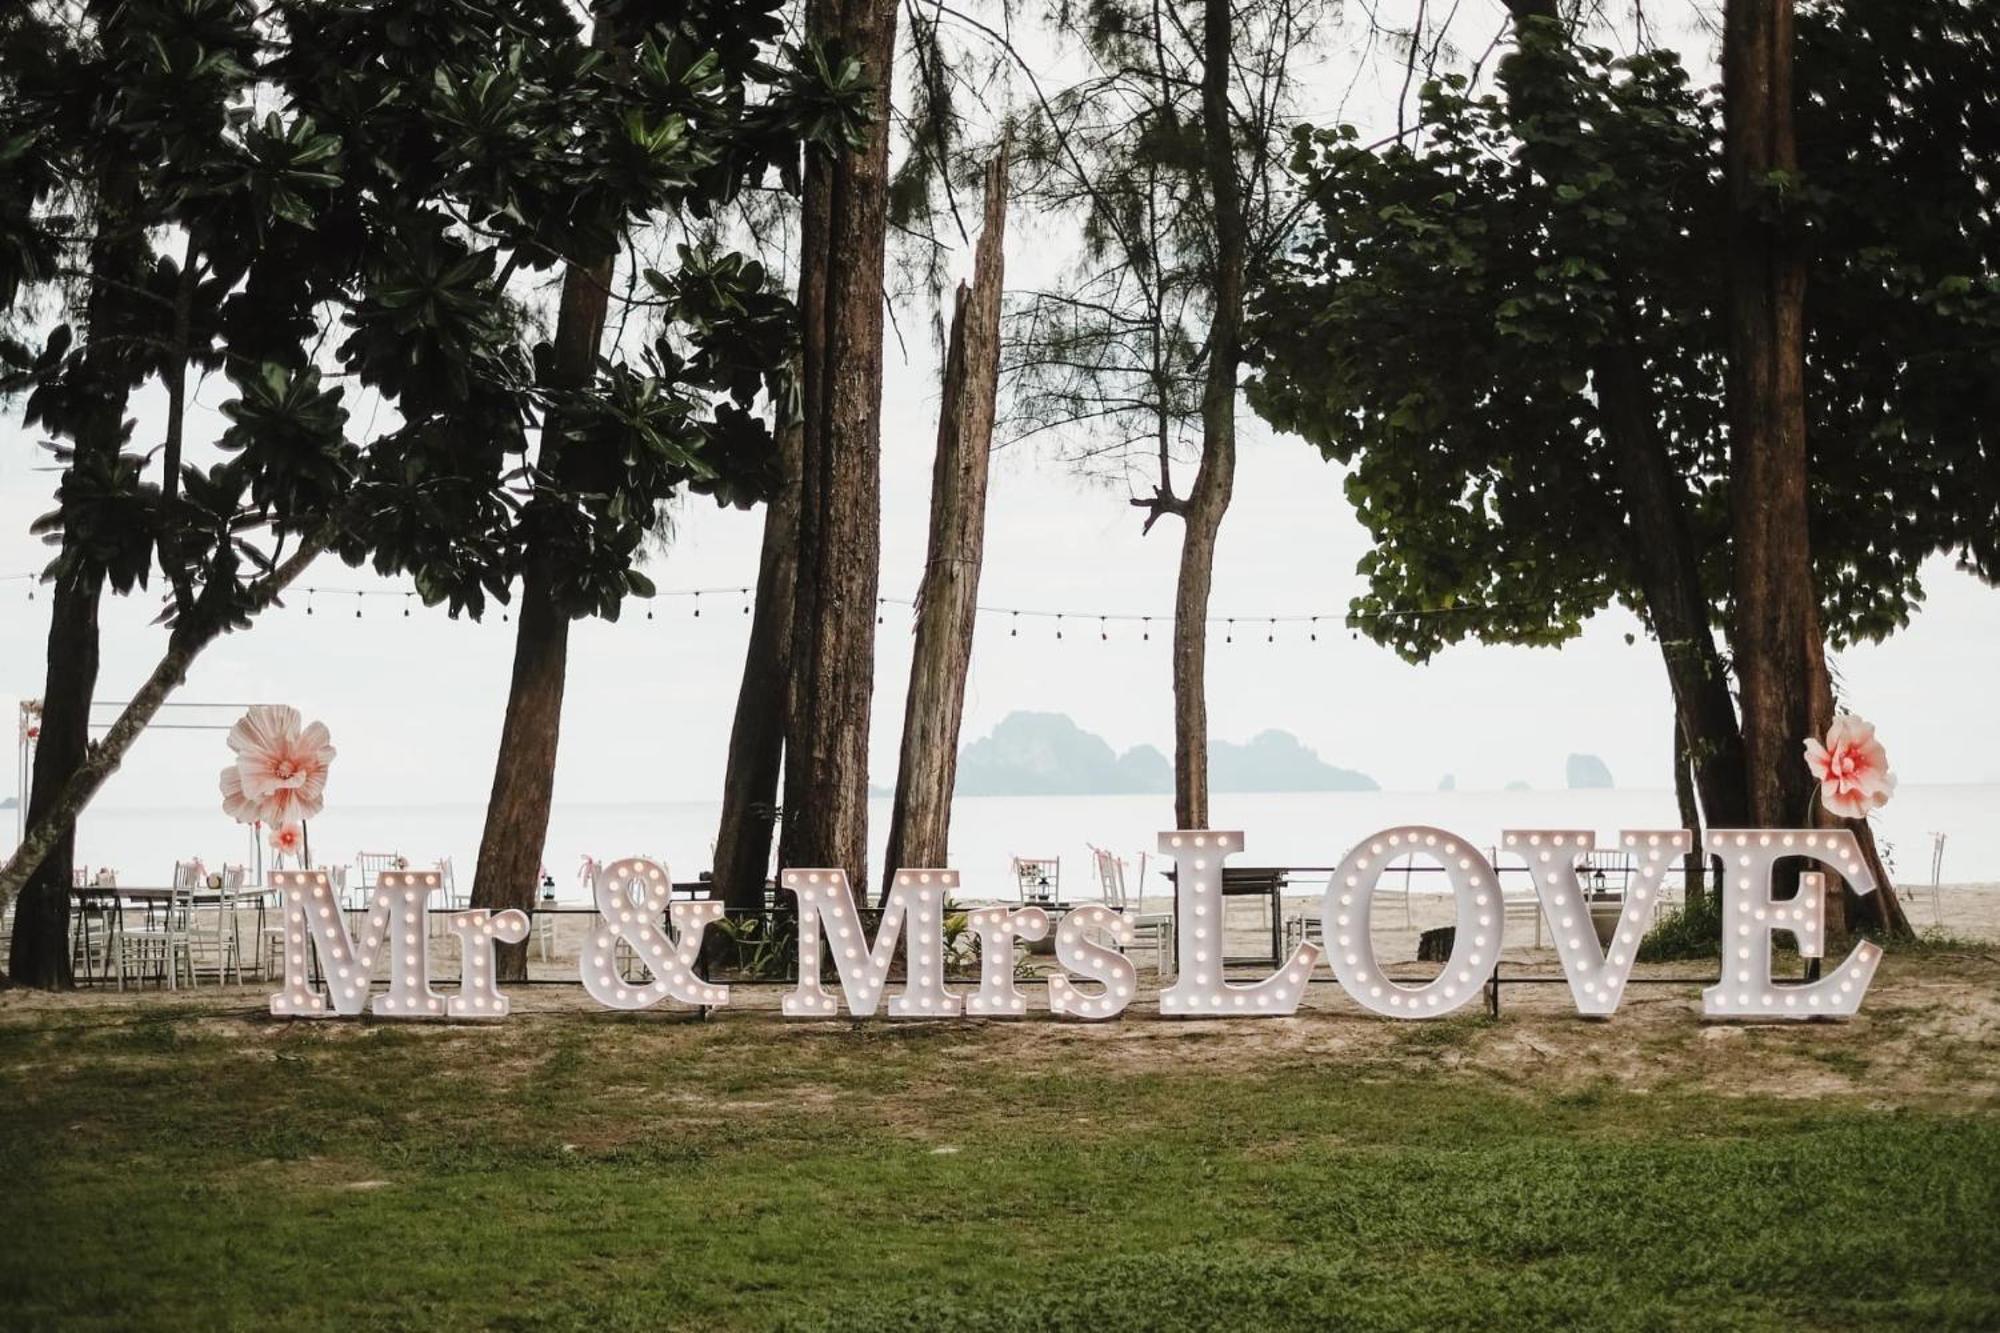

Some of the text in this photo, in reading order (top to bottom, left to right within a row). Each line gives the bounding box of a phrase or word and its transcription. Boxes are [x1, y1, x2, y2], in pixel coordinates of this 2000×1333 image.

[268, 825, 1883, 1019] Mr & Mrs LOVE
